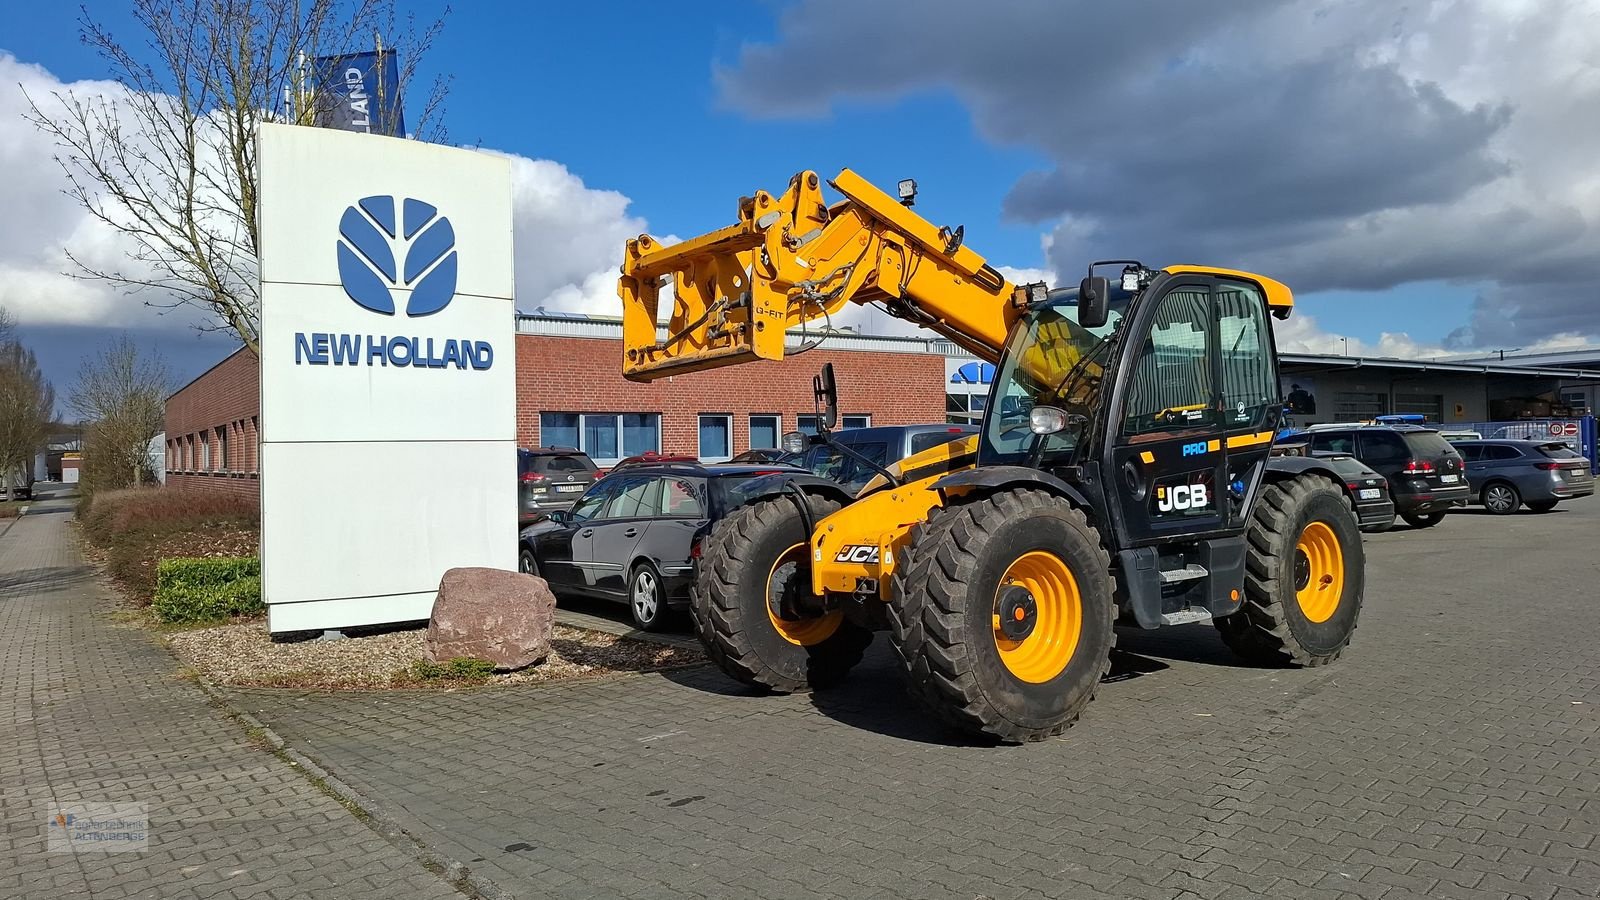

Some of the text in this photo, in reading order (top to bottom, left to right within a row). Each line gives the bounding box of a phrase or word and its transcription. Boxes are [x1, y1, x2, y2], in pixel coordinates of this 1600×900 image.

[294, 332, 494, 371] NEW HOLLAND
[1182, 441, 1207, 456] PRO
[1158, 483, 1208, 512] JCB
